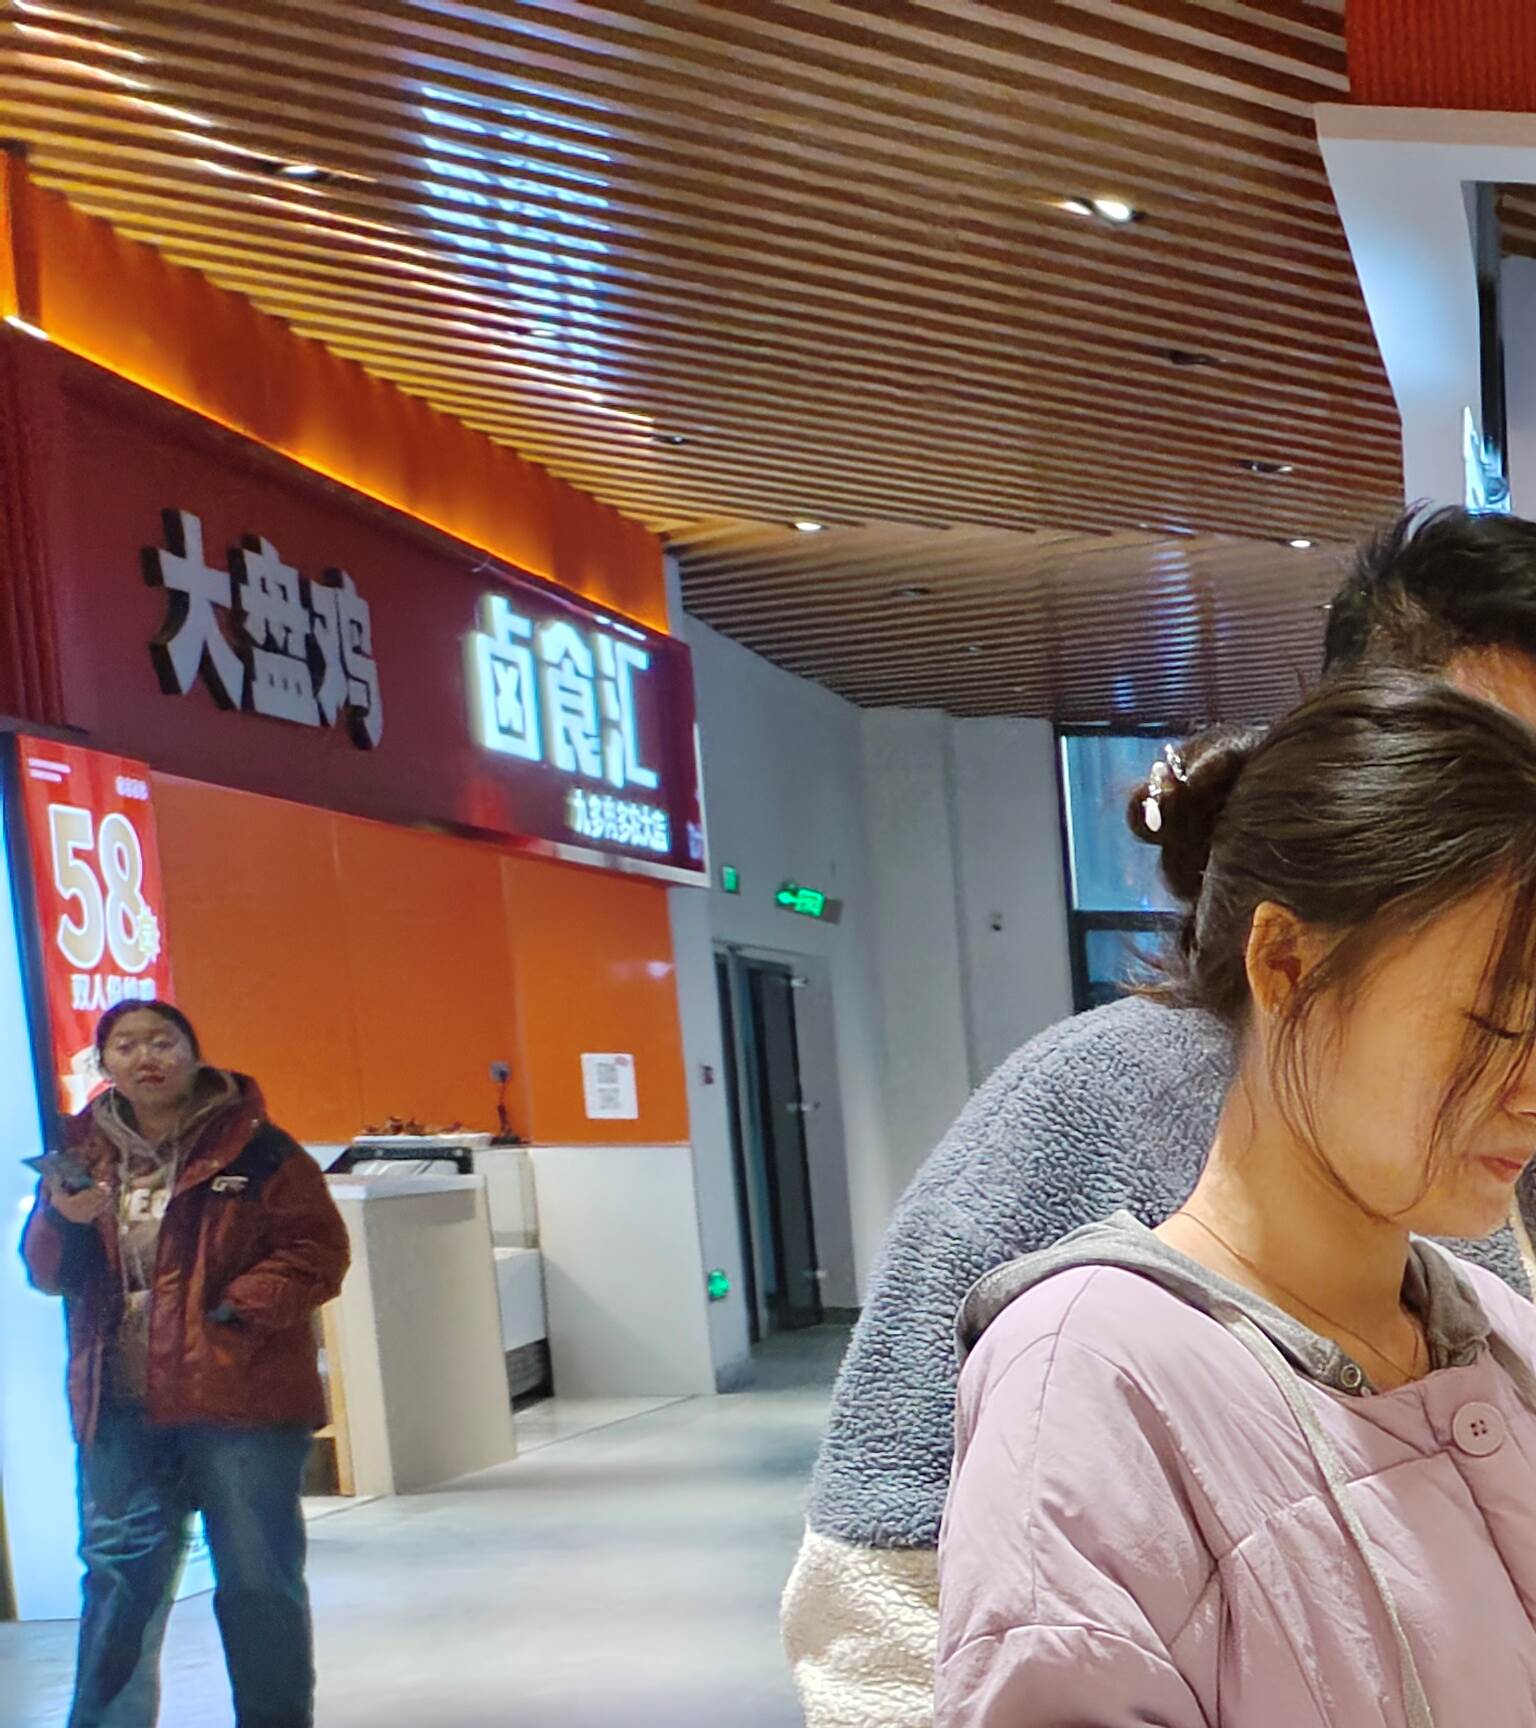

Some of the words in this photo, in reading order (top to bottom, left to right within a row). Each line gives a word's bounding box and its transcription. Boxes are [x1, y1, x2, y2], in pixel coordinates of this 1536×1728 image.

[154, 508, 384, 748] 大盘鸡
[472, 592, 660, 790] 卤食汇
[48, 803, 150, 973] 58
